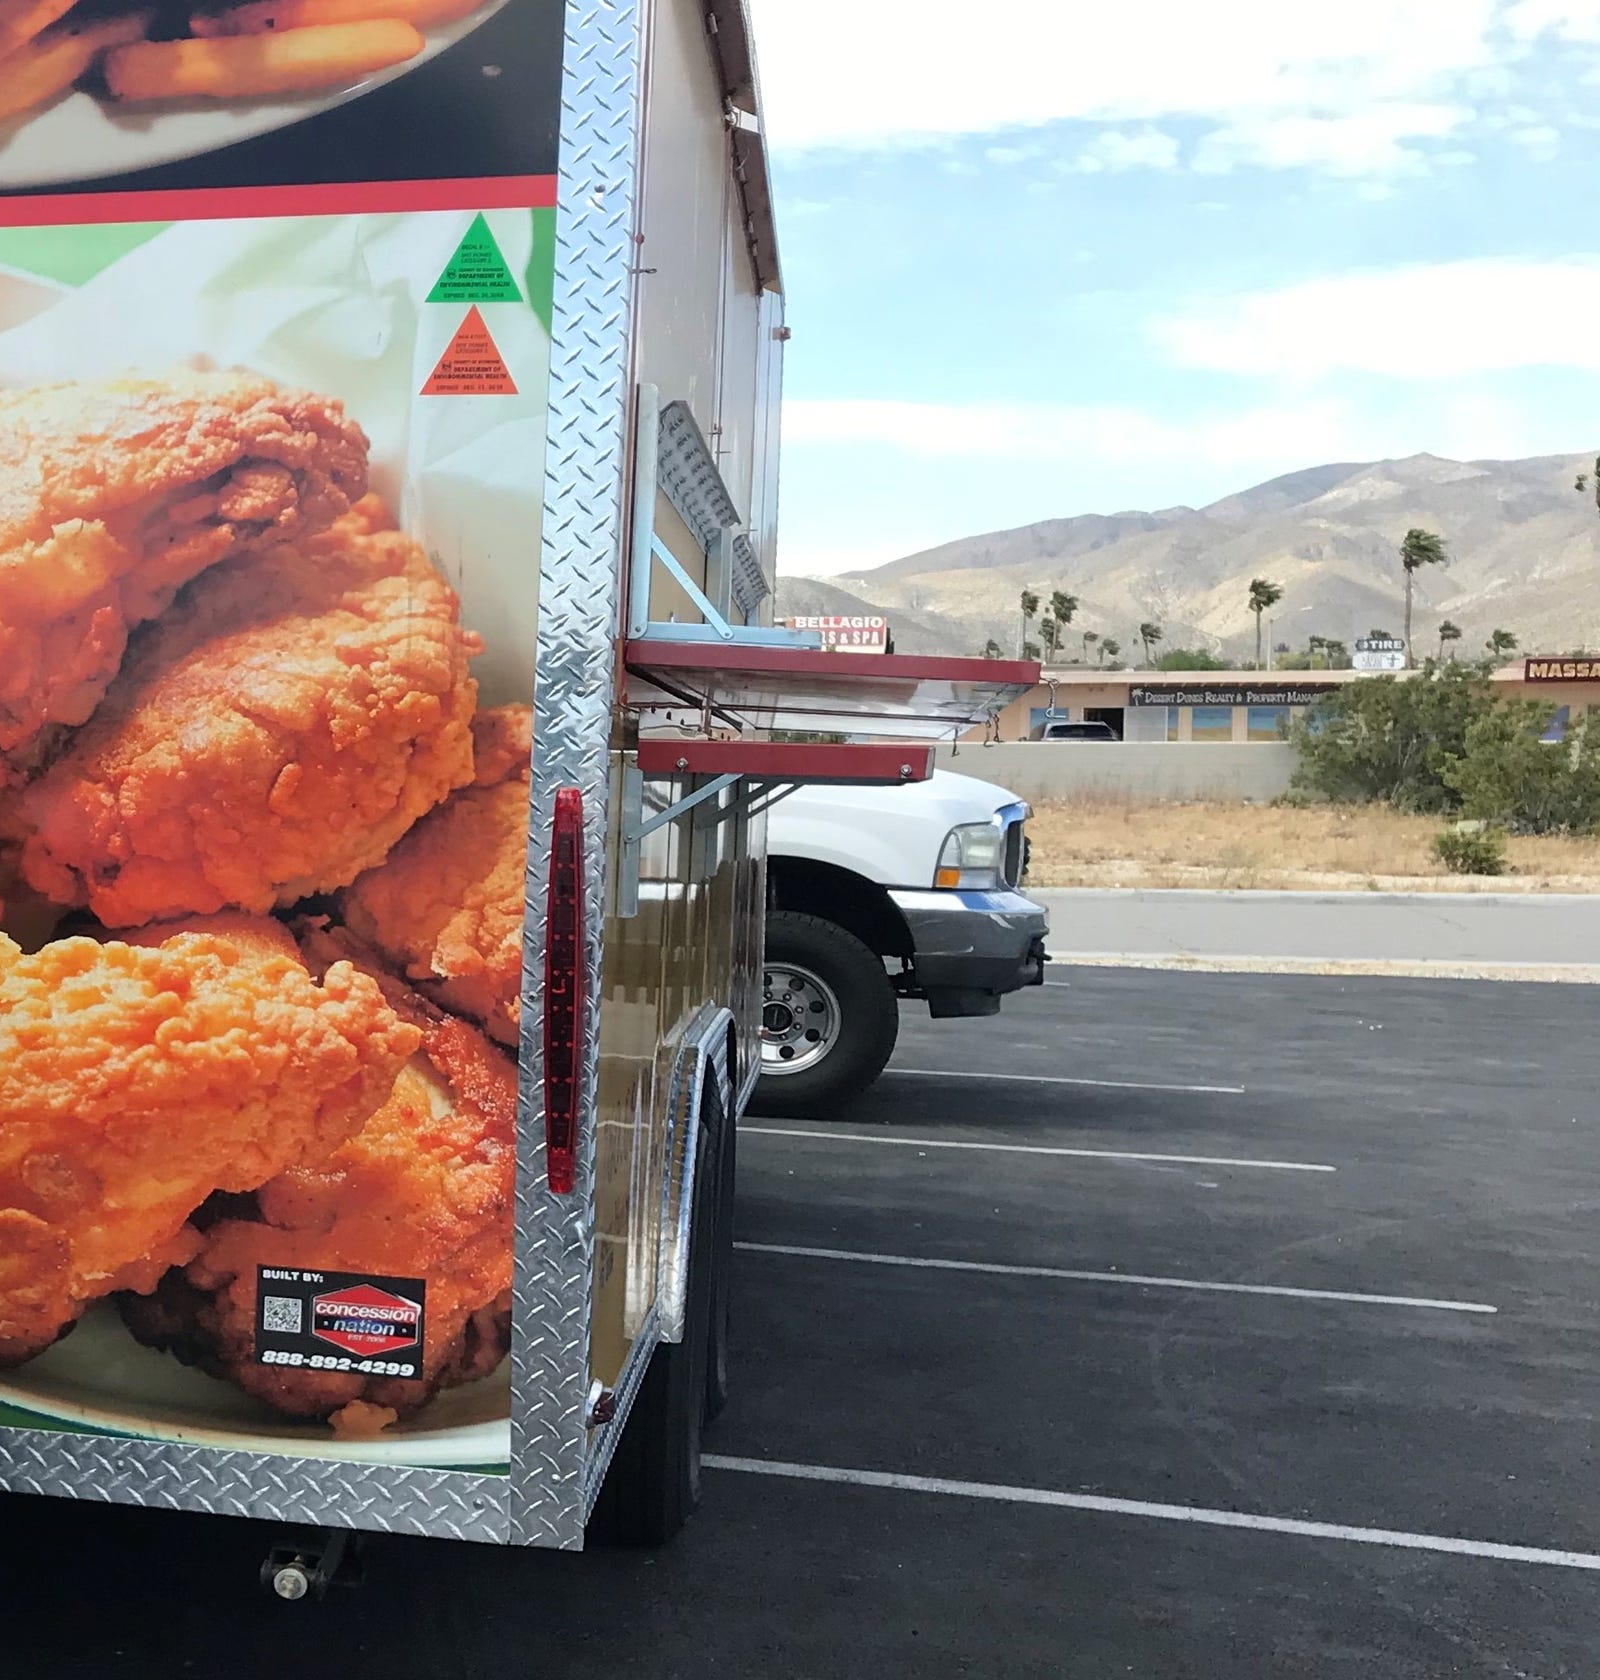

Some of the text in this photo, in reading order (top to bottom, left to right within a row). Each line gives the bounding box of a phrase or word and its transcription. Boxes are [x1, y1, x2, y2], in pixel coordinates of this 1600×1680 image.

[795, 616, 883, 628] BELLAGIO
[840, 632, 848, 644] &
[852, 630, 879, 644] SPA
[1369, 640, 1403, 650] TIRE
[1205, 691, 1234, 703] REALTY
[1246, 691, 1286, 703] PROPERTY
[262, 1269, 324, 1283] BUILT BY:
[316, 1303, 415, 1322] concession
[333, 1320, 395, 1336] nation
[261, 1350, 415, 1377] 888-892-4299
